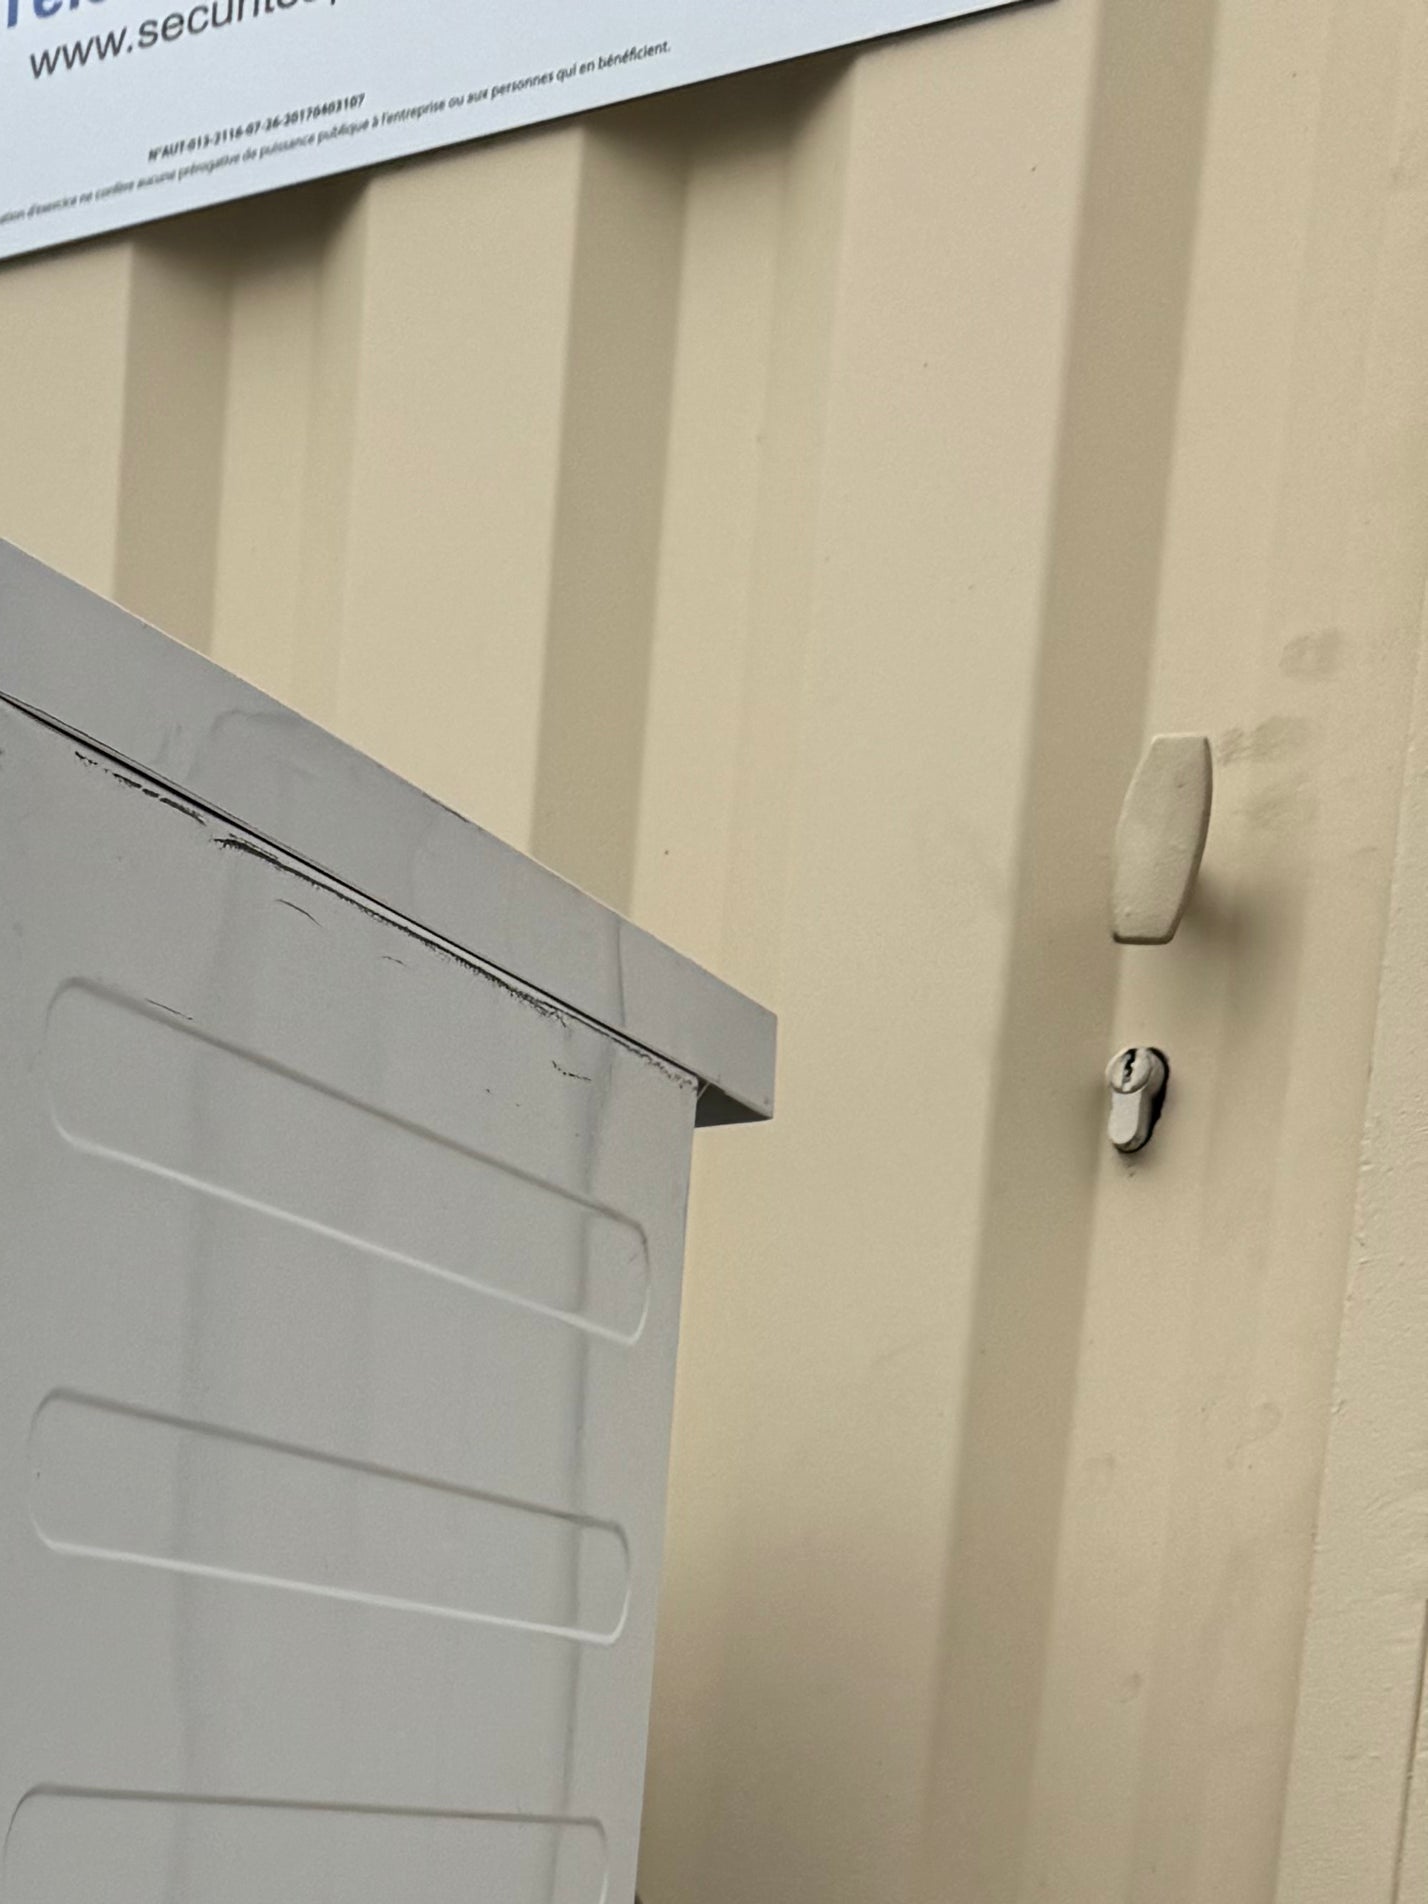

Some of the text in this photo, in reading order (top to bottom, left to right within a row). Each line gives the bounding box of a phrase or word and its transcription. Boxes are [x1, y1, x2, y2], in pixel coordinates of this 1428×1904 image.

[381, 99, 446, 126] l'entreprise
[448, 94, 465, 109] ou
[467, 87, 489, 105] aux
[491, 71, 554, 101] personnes
[556, 62, 577, 84] qui
[579, 62, 595, 76] en
[598, 41, 671, 70] bénéficient.
